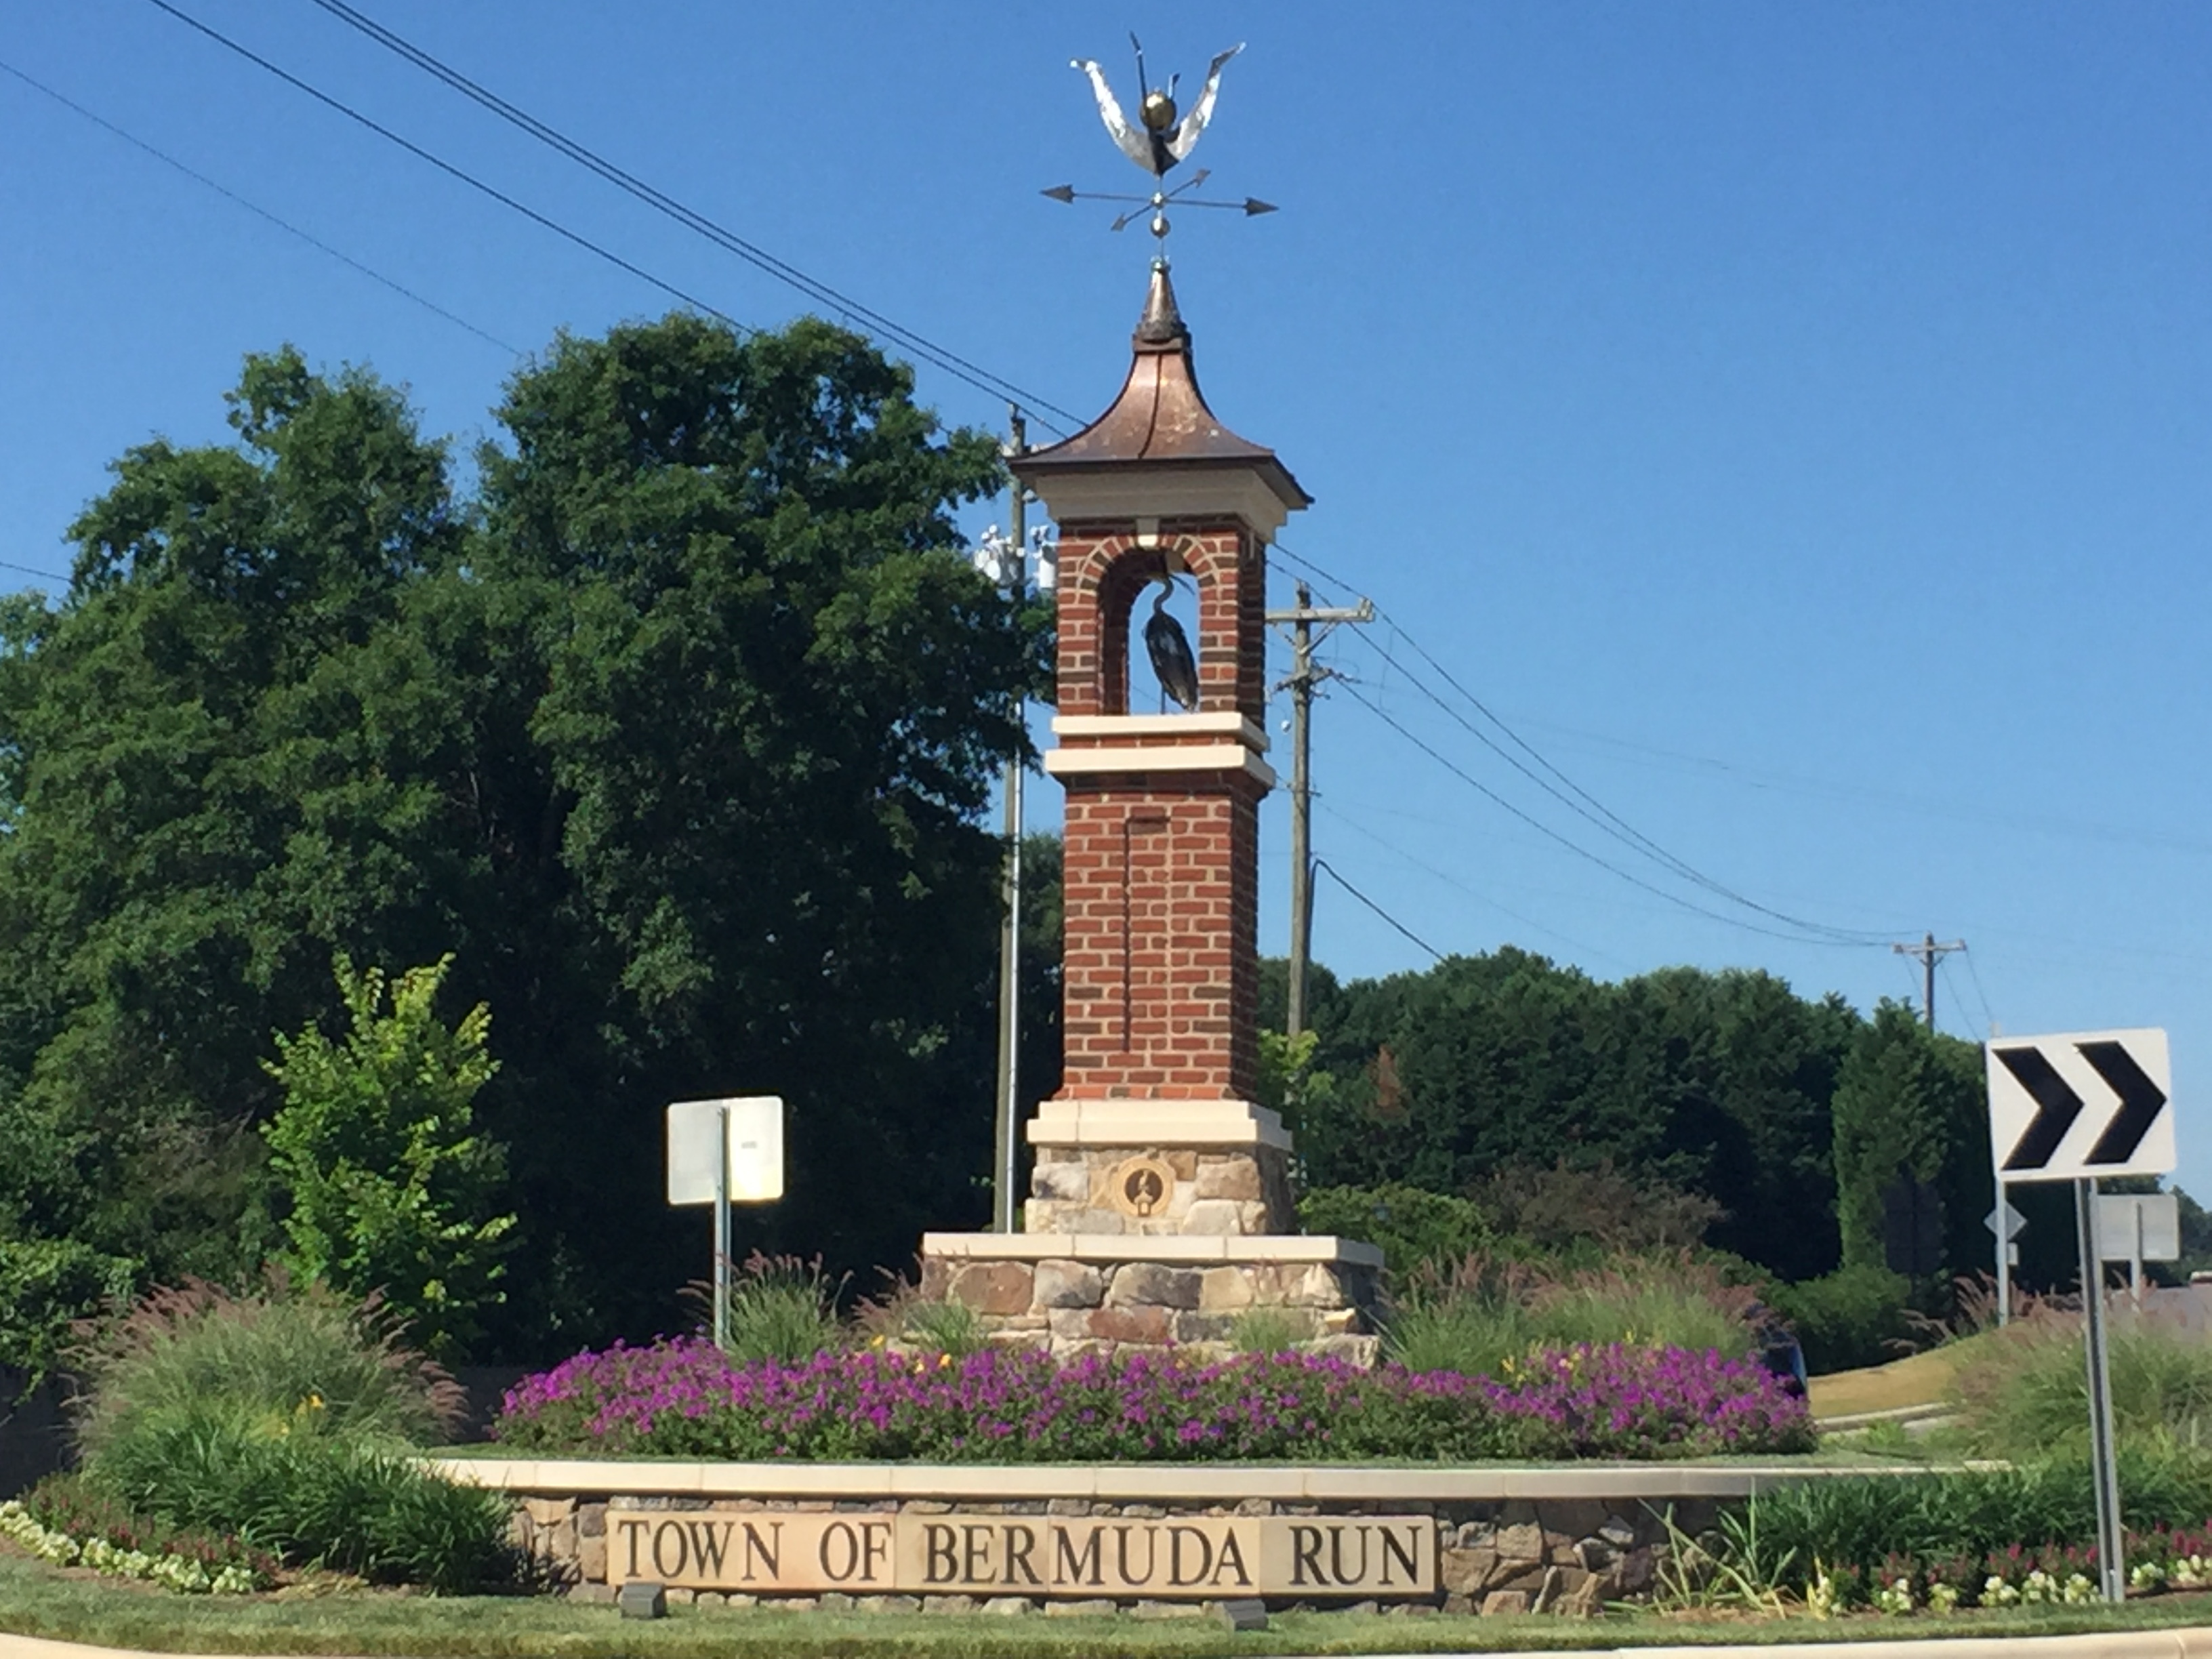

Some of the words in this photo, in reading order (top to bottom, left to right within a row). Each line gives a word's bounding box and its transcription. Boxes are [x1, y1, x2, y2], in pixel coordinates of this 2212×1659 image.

[617, 1520, 784, 1581] TOWN
[819, 1521, 892, 1582] OF
[924, 1523, 1252, 1586] BERMUDA
[1289, 1524, 1422, 1586] RUN
